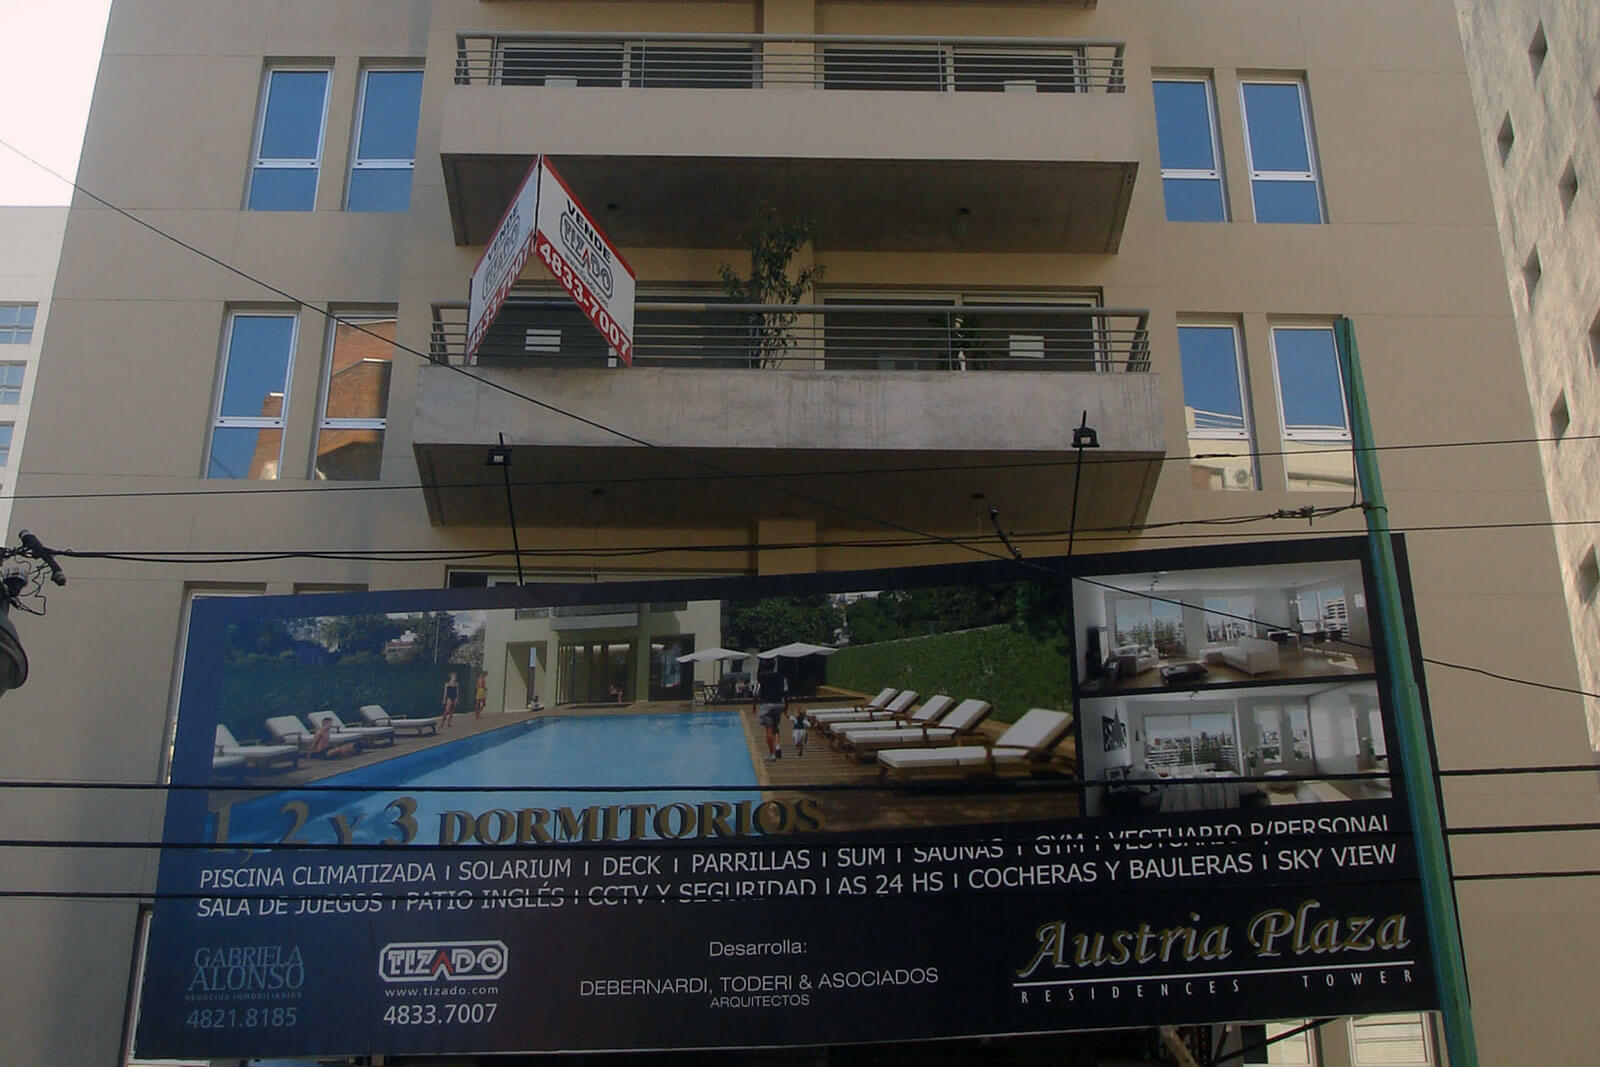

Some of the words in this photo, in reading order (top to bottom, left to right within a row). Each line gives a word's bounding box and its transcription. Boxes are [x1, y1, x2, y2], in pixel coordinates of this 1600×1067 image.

[566, 198, 613, 265] VENDE
[563, 217, 612, 292] TIZADO
[539, 243, 632, 356] 4833-7007
[379, 796, 419, 847] 3
[437, 800, 826, 848] DORMITORIOS
[198, 898, 251, 917] SALA
[258, 895, 288, 915] DE
[295, 891, 383, 914] JUEGOS
[406, 889, 473, 911] PATIO
[481, 882, 565, 909] INGLÉS
[588, 885, 649, 905] CCTV
[656, 884, 672, 903] Y
[875, 874, 904, 895] 24
[911, 870, 945, 892] HS
[967, 862, 1098, 889] COCHERAS
[1104, 861, 1121, 881] Y
[1130, 853, 1254, 880] BAULERAS
[1277, 849, 1324, 871] SKY
[1330, 843, 1397, 867] VIEW
[200, 867, 285, 889] PISCINA
[291, 862, 437, 886] CLIMATIZADA
[458, 858, 572, 881] SOLARIUM
[602, 856, 662, 876] DECK
[691, 850, 811, 873] PARRILLAS
[836, 846, 887, 868] SUM
[709, 940, 808, 956] Desarrolla:
[1015, 910, 1233, 978] Austria
[1247, 899, 1411, 957] Plaza
[193, 945, 305, 970] GABRIELA
[388, 949, 503, 976] TIZADO
[186, 966, 305, 991] ALONSO
[384, 986, 499, 997] www.tizado.com
[580, 977, 714, 996] DEBERNARDI,
[720, 974, 793, 993] TODERI
[799, 972, 812, 990] &
[818, 967, 939, 989] ASOCIADOS
[1020, 978, 1240, 1004] RESIDENCES
[1302, 969, 1412, 989] TOWER
[383, 1003, 499, 1025] 4833.7007
[710, 994, 810, 1008] ARQUITECTOS
[186, 1007, 298, 1028] 4821.8185
